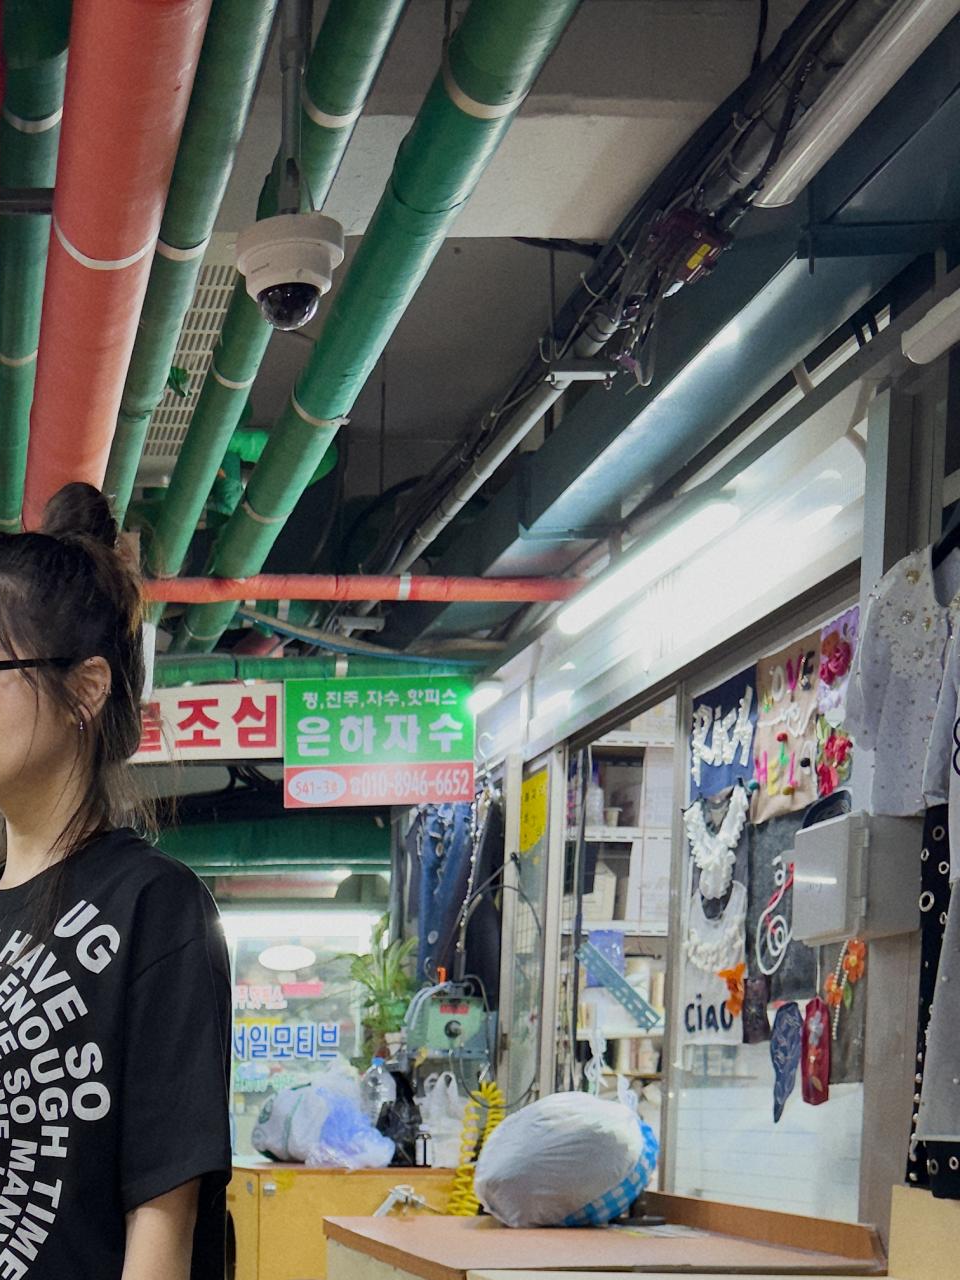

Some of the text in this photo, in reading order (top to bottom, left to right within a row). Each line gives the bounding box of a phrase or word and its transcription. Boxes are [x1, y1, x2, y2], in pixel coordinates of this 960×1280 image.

[297, 713, 463, 757] 은하자수
[3, 1067, 37, 1124] SO
[65, 1042, 111, 1122] SO
